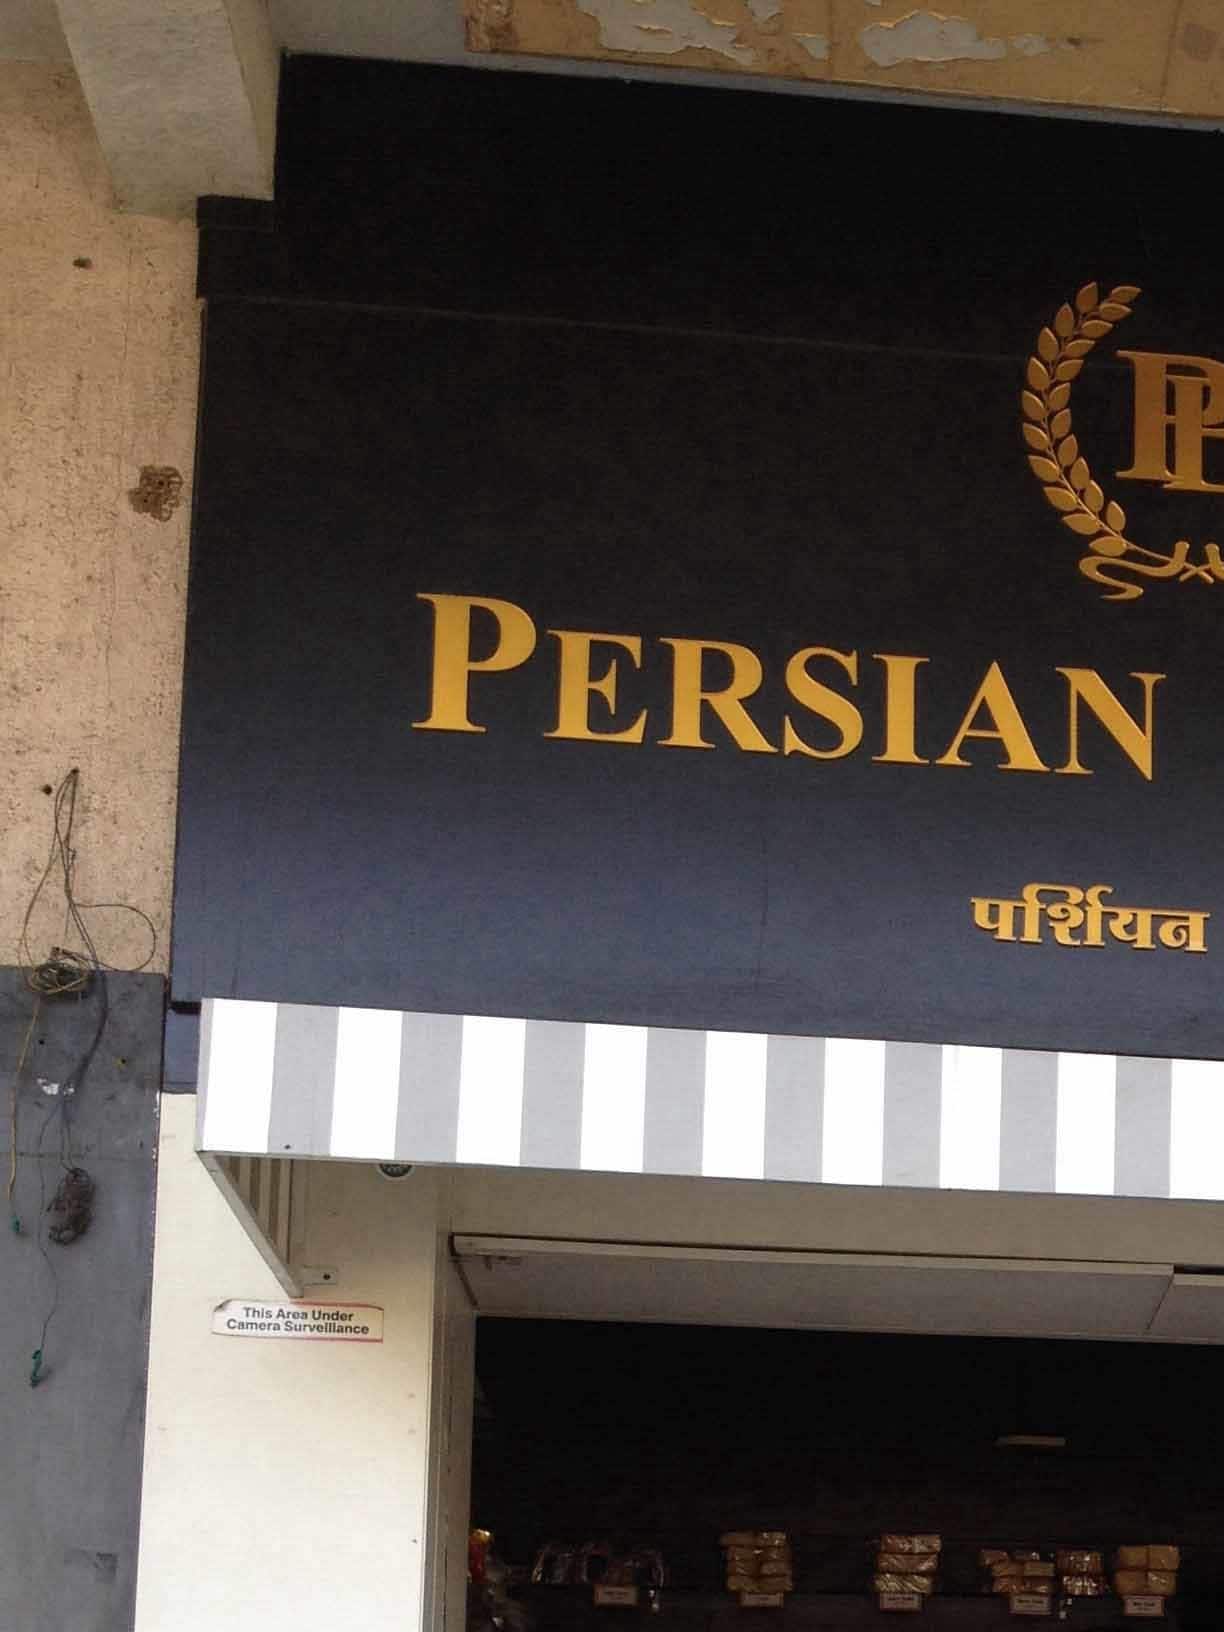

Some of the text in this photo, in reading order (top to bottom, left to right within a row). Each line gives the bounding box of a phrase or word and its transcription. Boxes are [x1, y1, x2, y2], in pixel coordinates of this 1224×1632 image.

[411, 592, 1167, 781] PERSIAN
[243, 1306, 354, 1322] This Area Under
[226, 1318, 370, 1335] Camera Surveillance
